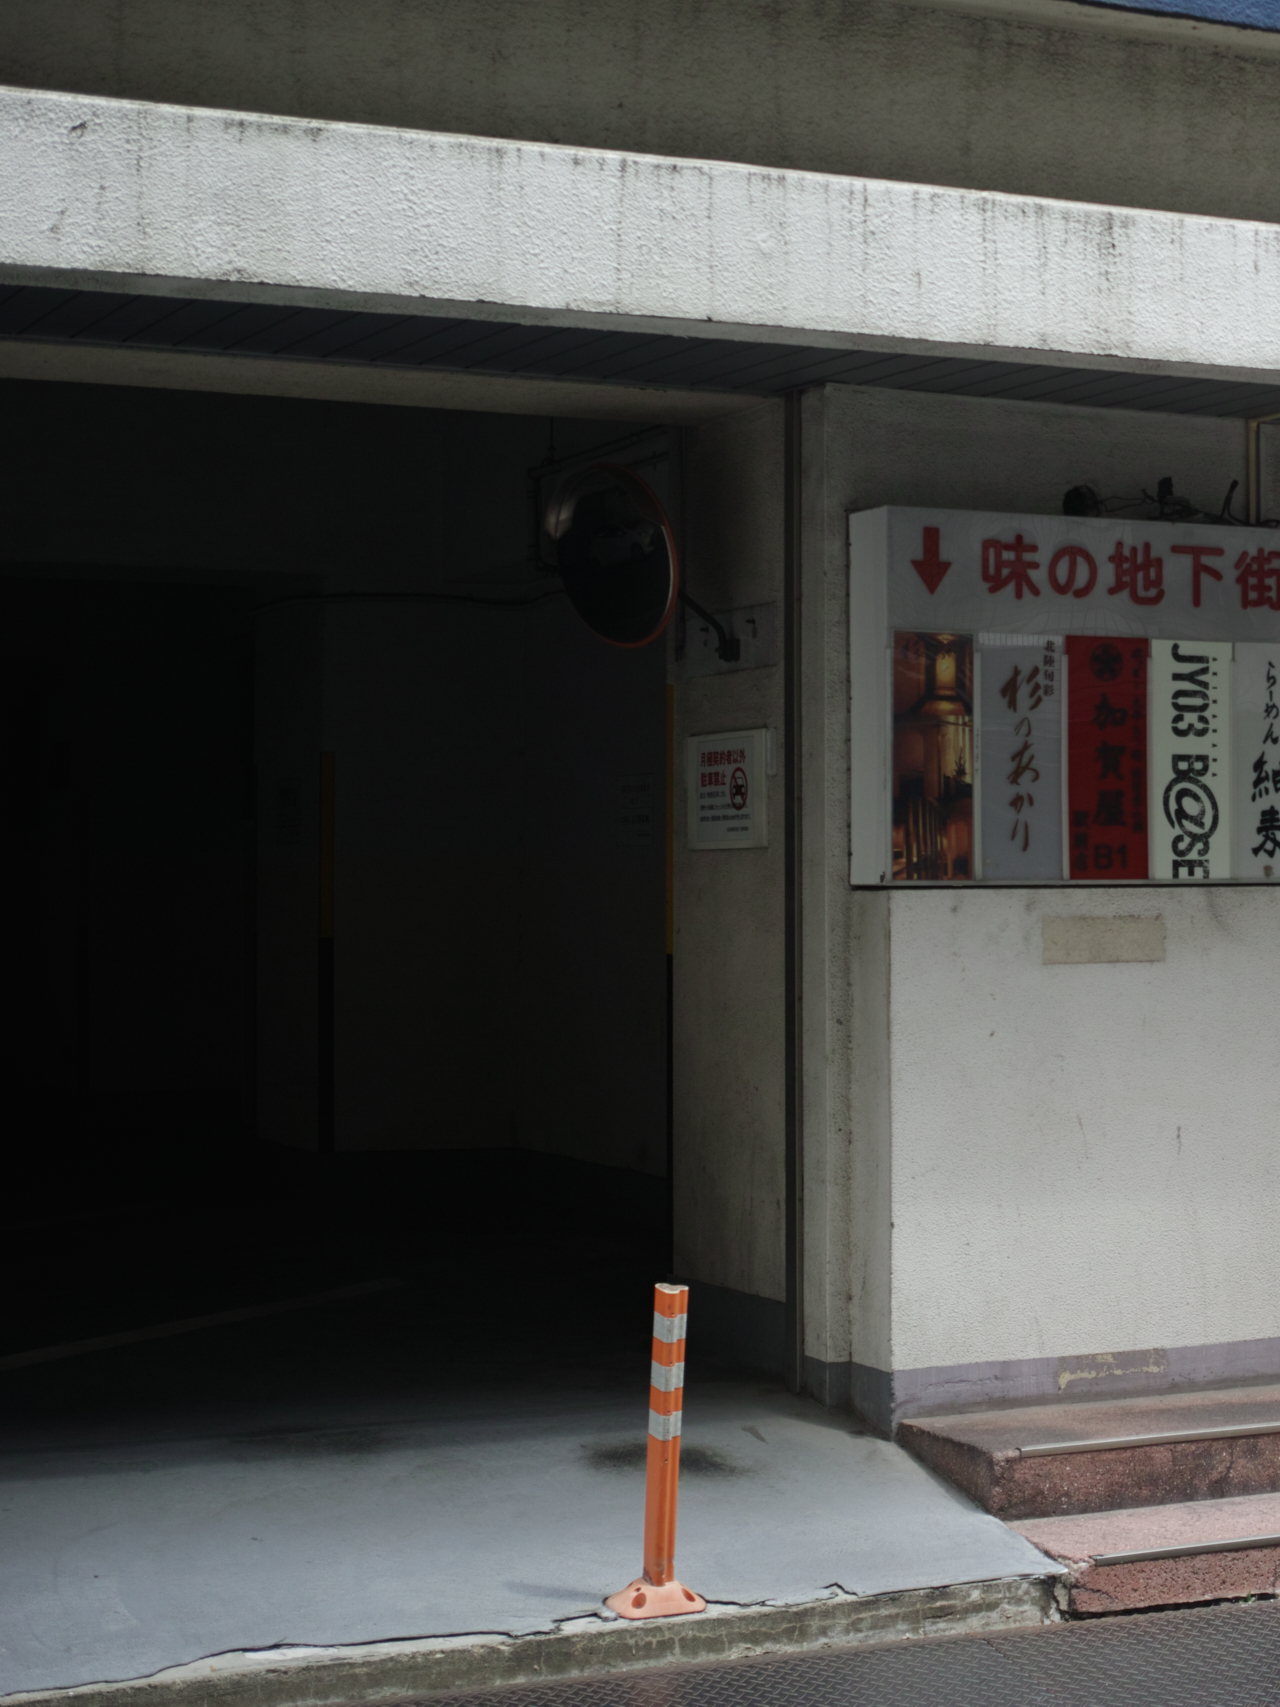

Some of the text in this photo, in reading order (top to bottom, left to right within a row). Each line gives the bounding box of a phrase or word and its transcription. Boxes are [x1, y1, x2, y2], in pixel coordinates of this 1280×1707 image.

[1043, 640, 1055, 697] 北陸旬彩
[1172, 643, 1210, 738] JY03
[1263, 661, 1280, 746] らーめん
[1000, 665, 1042, 852] 杉のあかり
[1093, 843, 1128, 870] B1
